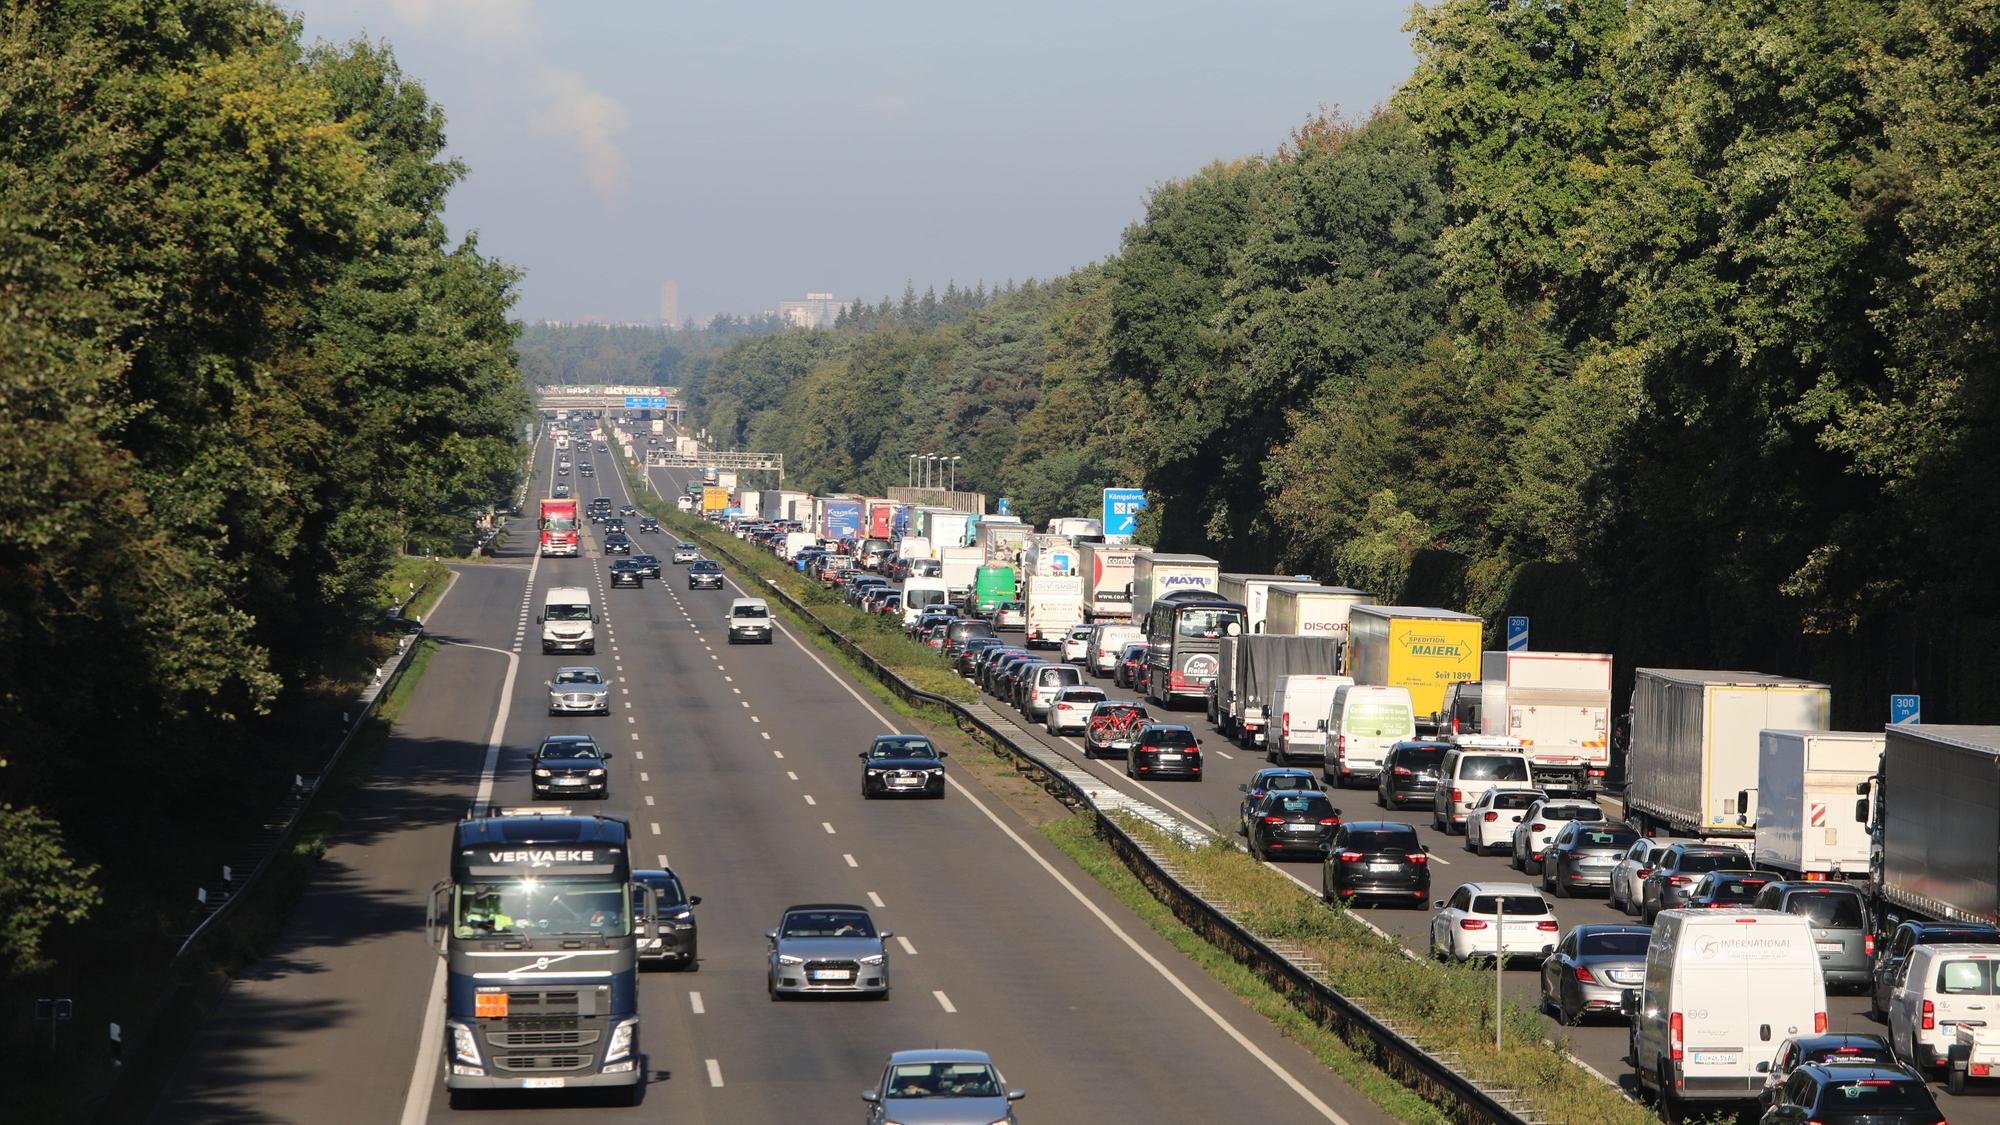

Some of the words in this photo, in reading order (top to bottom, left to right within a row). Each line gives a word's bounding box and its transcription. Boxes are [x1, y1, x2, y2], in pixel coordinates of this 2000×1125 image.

[1165, 576, 1205, 588] MAYR
[1409, 636, 1446, 644] SPEDITION
[1412, 645, 1461, 656] MAIERL
[1435, 671, 1450, 679] Seit
[1453, 672, 1472, 680] 1899
[1896, 698, 1914, 708] 300
[489, 851, 594, 862] VERVAEKE
[1721, 938, 1792, 948] INTERNATIONAL
